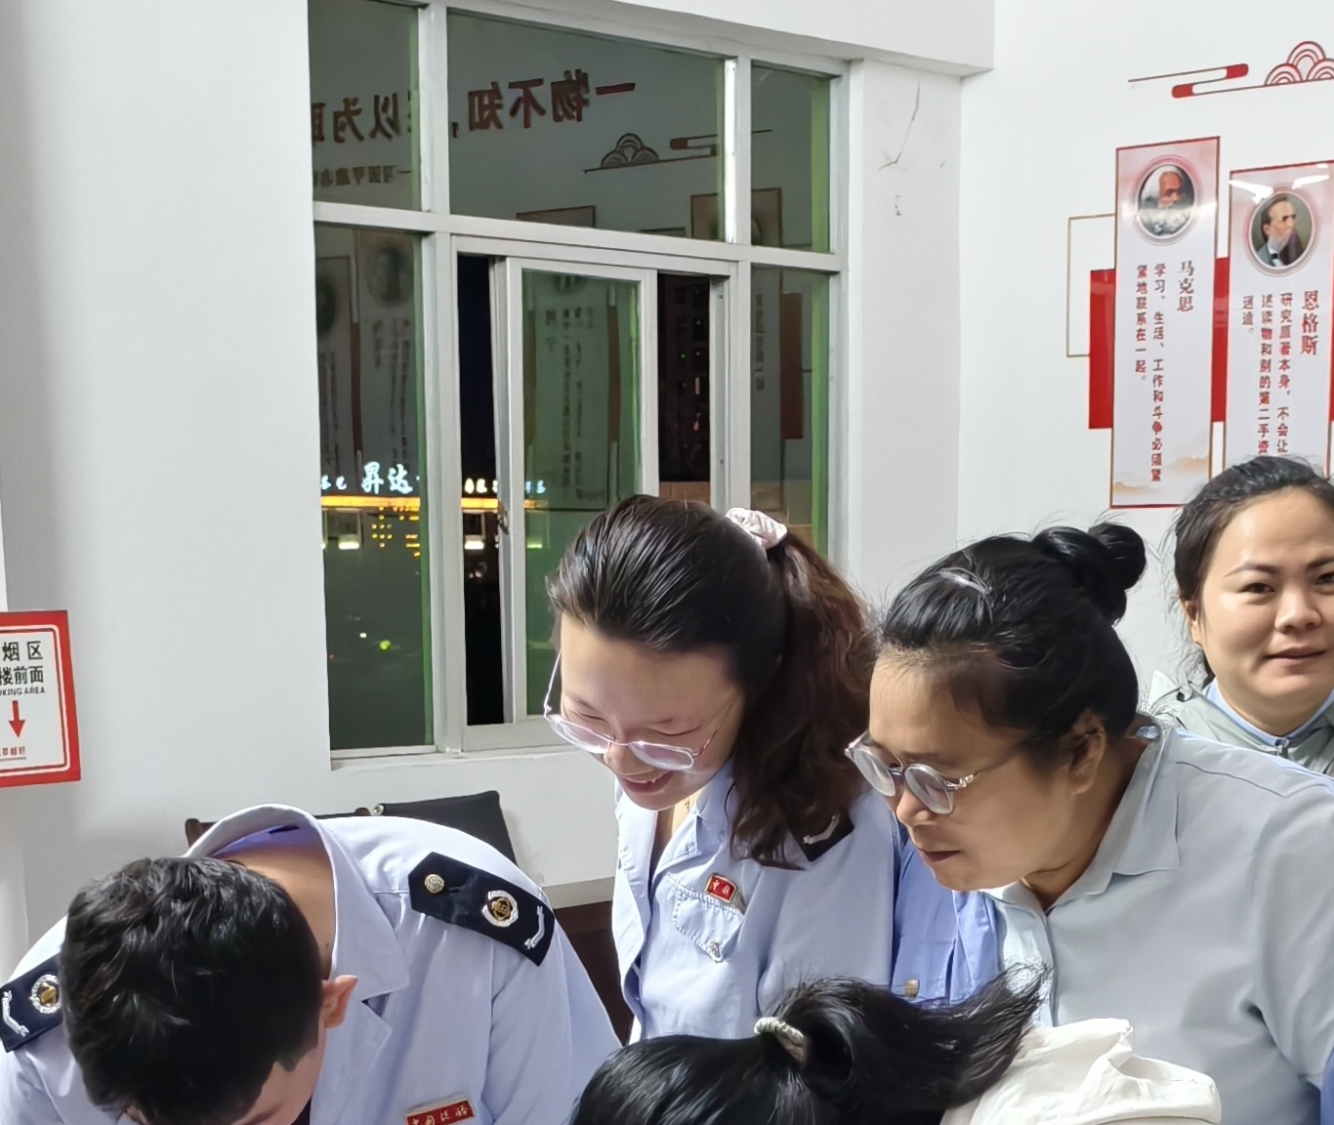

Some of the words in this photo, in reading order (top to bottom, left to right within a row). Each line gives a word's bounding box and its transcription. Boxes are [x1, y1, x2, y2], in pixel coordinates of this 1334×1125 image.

[1177, 260, 1195, 312] 马克思
[1300, 290, 1319, 356] 恩格斯
[24, 686, 45, 695] AREA
